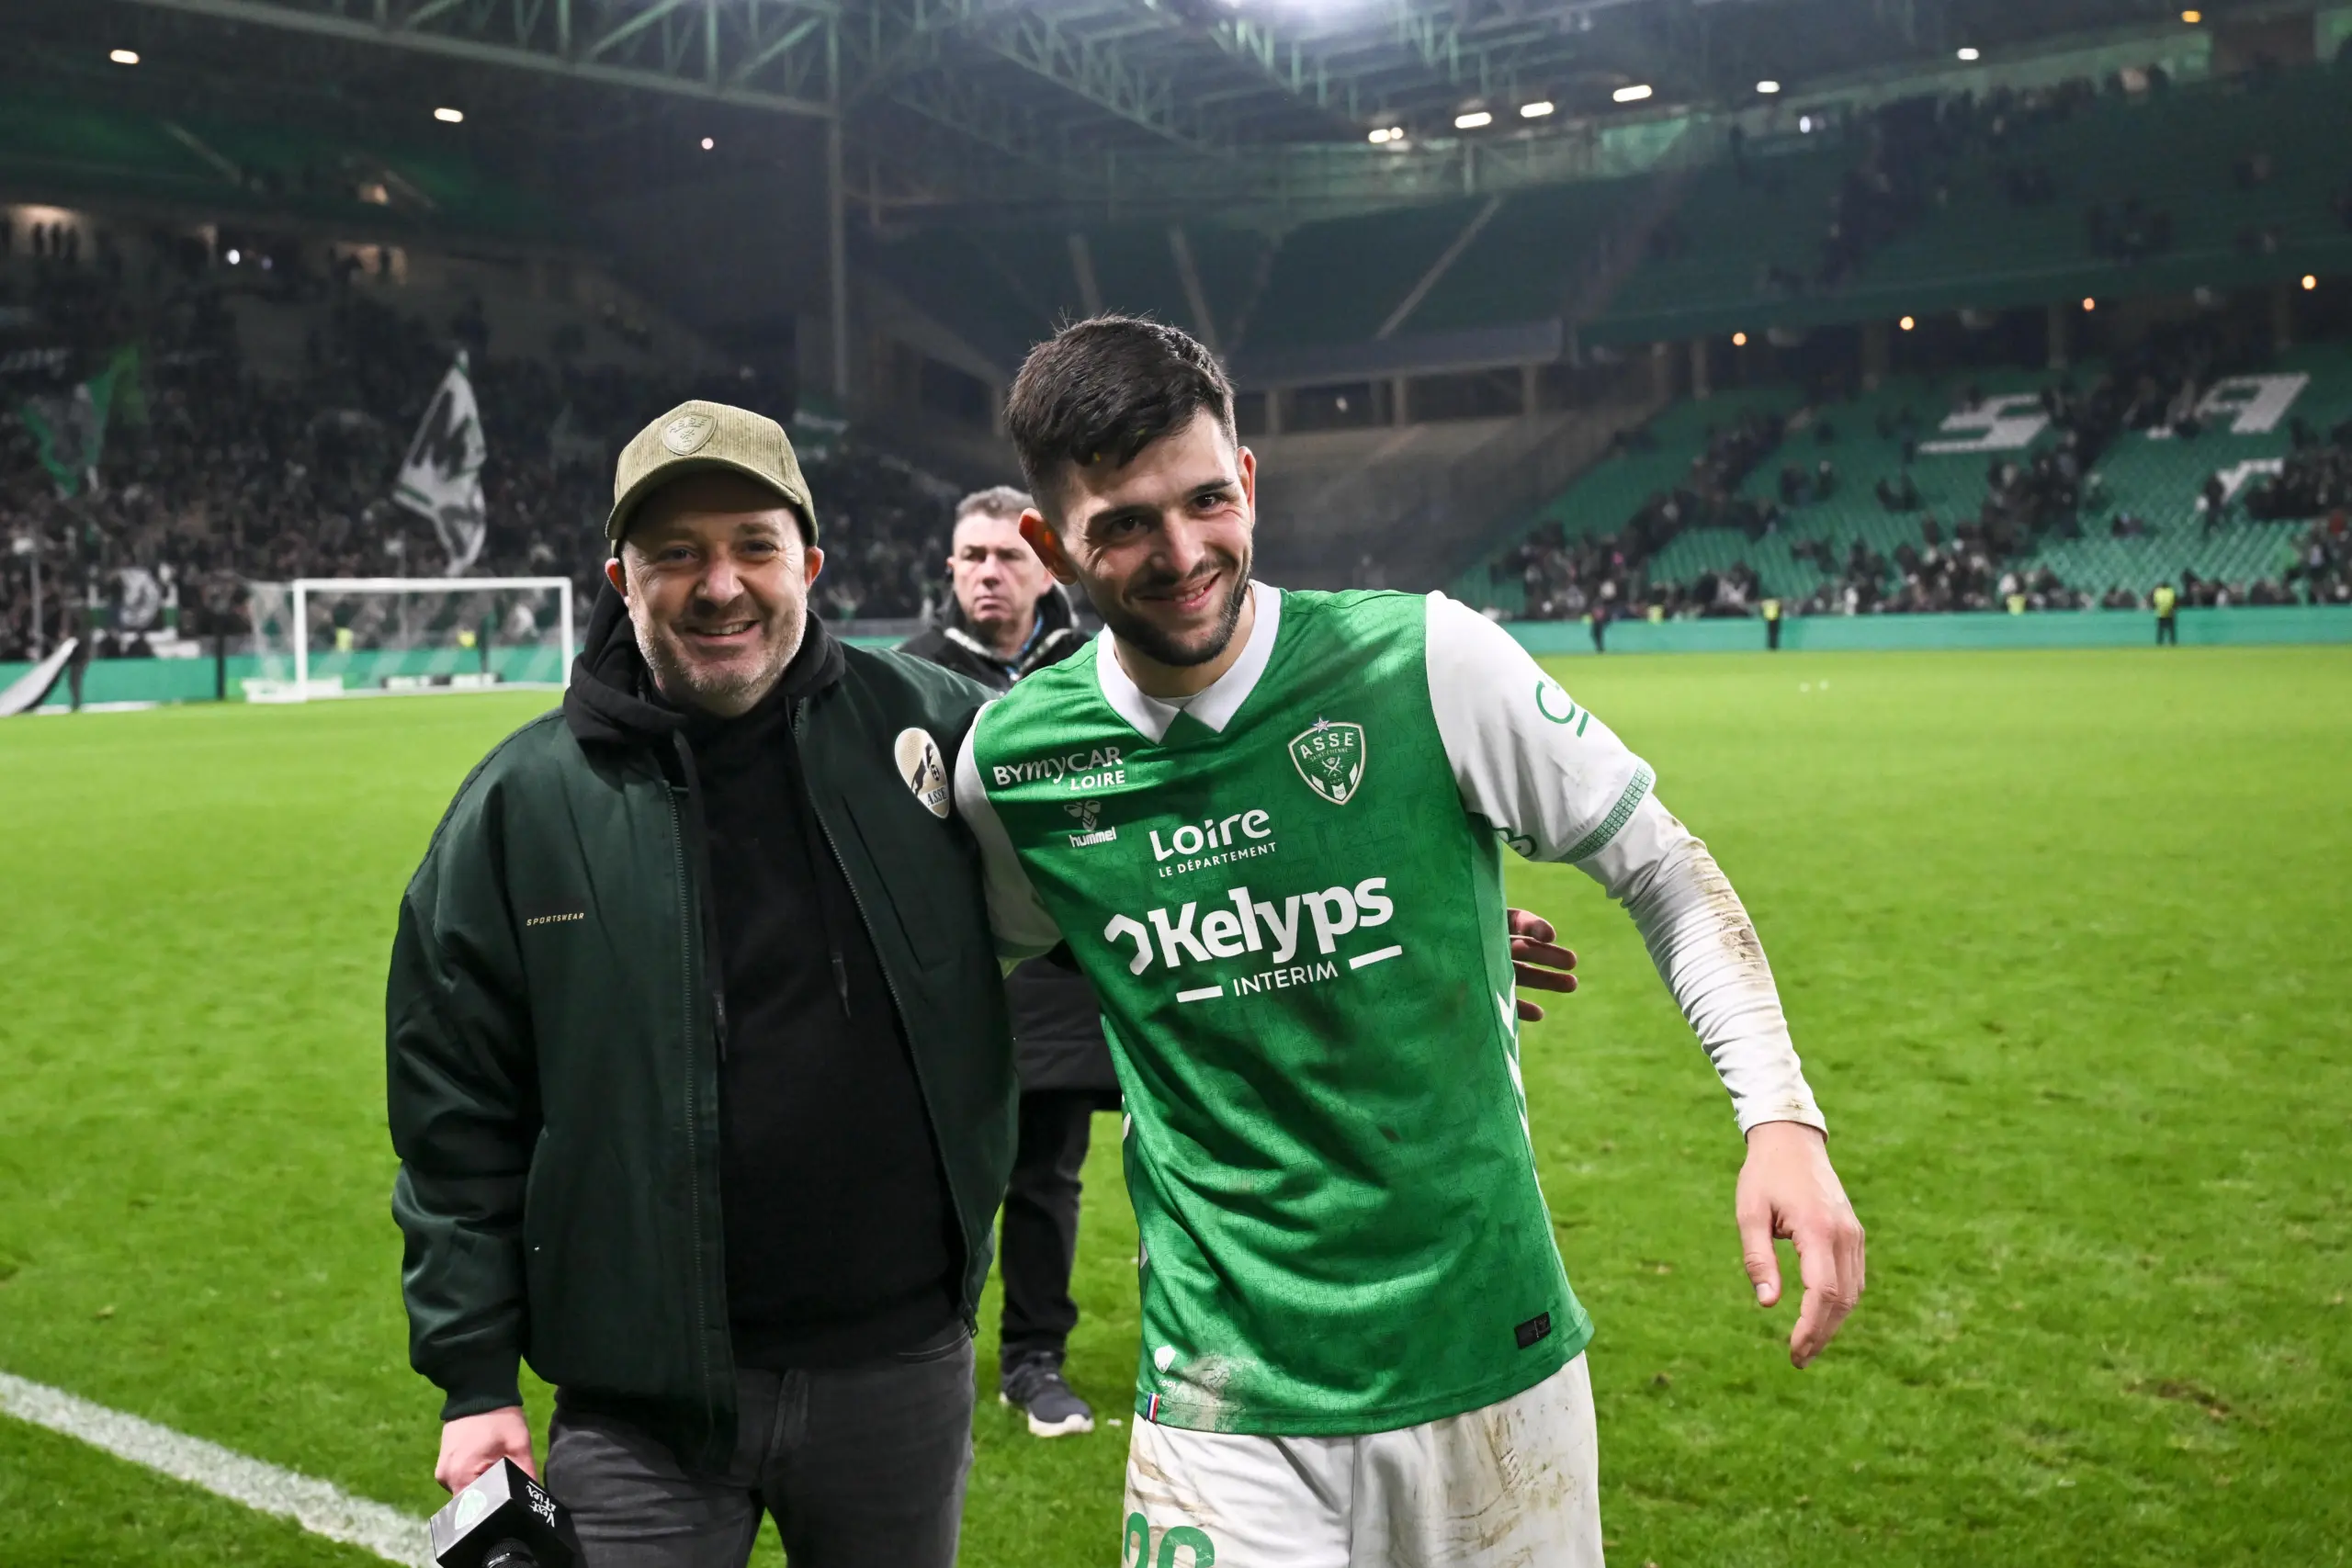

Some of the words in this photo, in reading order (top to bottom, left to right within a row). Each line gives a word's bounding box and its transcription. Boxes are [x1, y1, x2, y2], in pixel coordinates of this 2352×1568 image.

[1300, 732, 1355, 760] ASSE
[1069, 770, 1125, 791] LOIRE
[927, 786, 947, 807] ASSE
[1069, 826, 1117, 848] hummel
[1159, 866, 1173, 878] LE
[1177, 841, 1276, 874] DÉPARTEMENT
[526, 912, 584, 926] SPORTSWEAR
[1147, 877, 1394, 968] Kelyps
[1232, 960, 1339, 998] INTERIM
[527, 1501, 555, 1529] Vert
